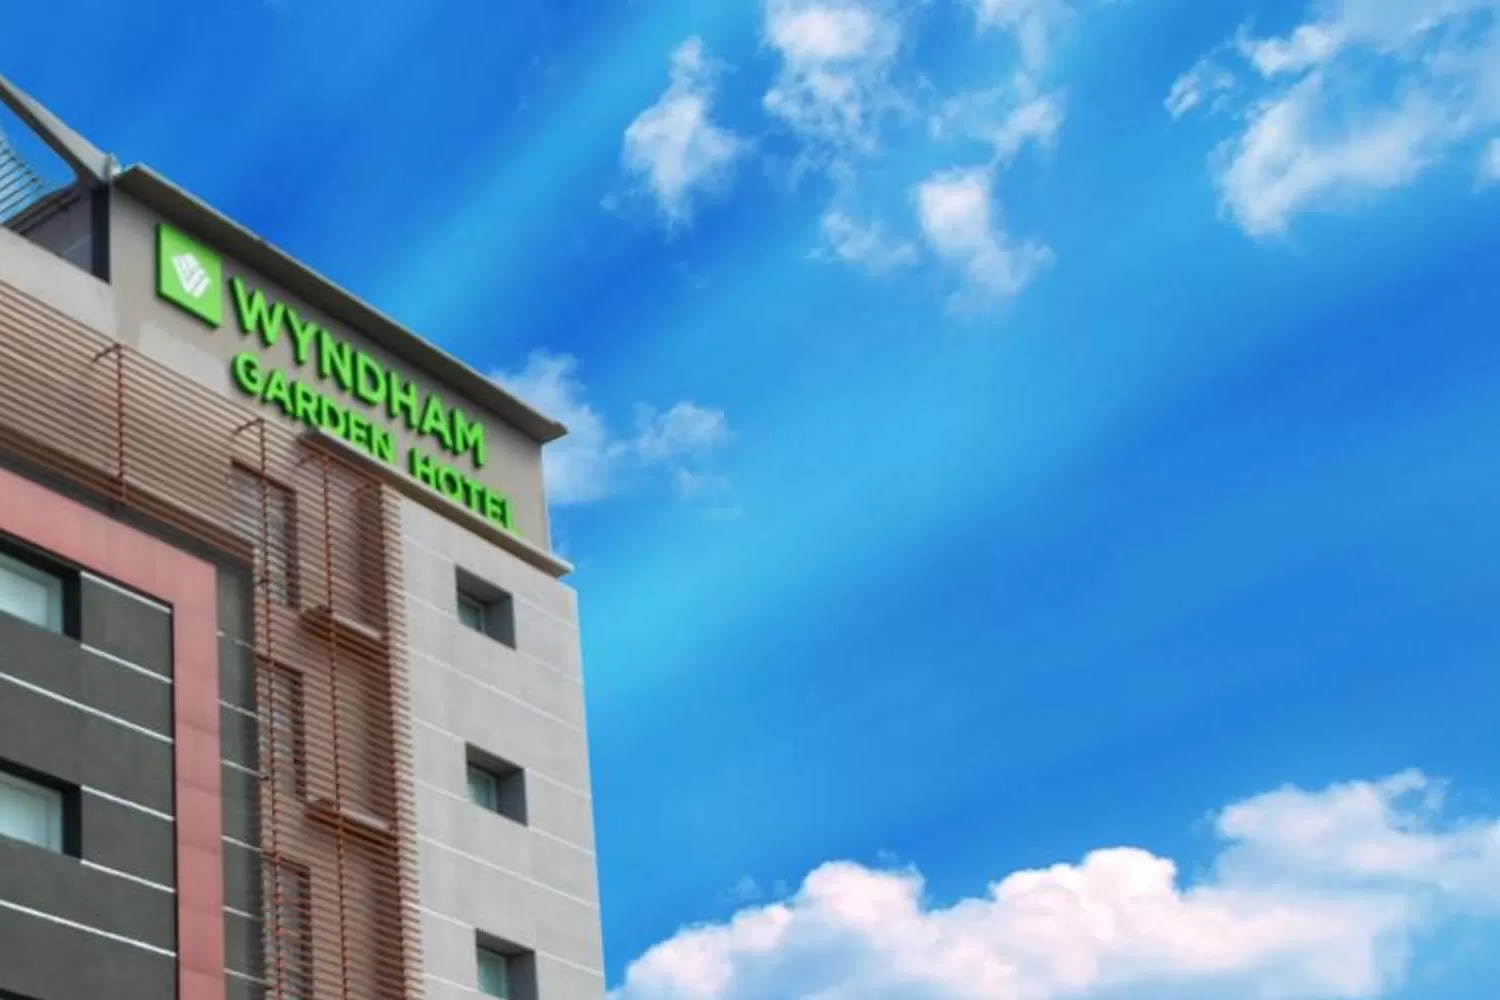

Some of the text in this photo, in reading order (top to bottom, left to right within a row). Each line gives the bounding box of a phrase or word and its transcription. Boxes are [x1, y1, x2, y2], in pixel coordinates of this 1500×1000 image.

[230, 276, 486, 468] WYNDHAM
[232, 351, 519, 538] GARDEN HOTEL
